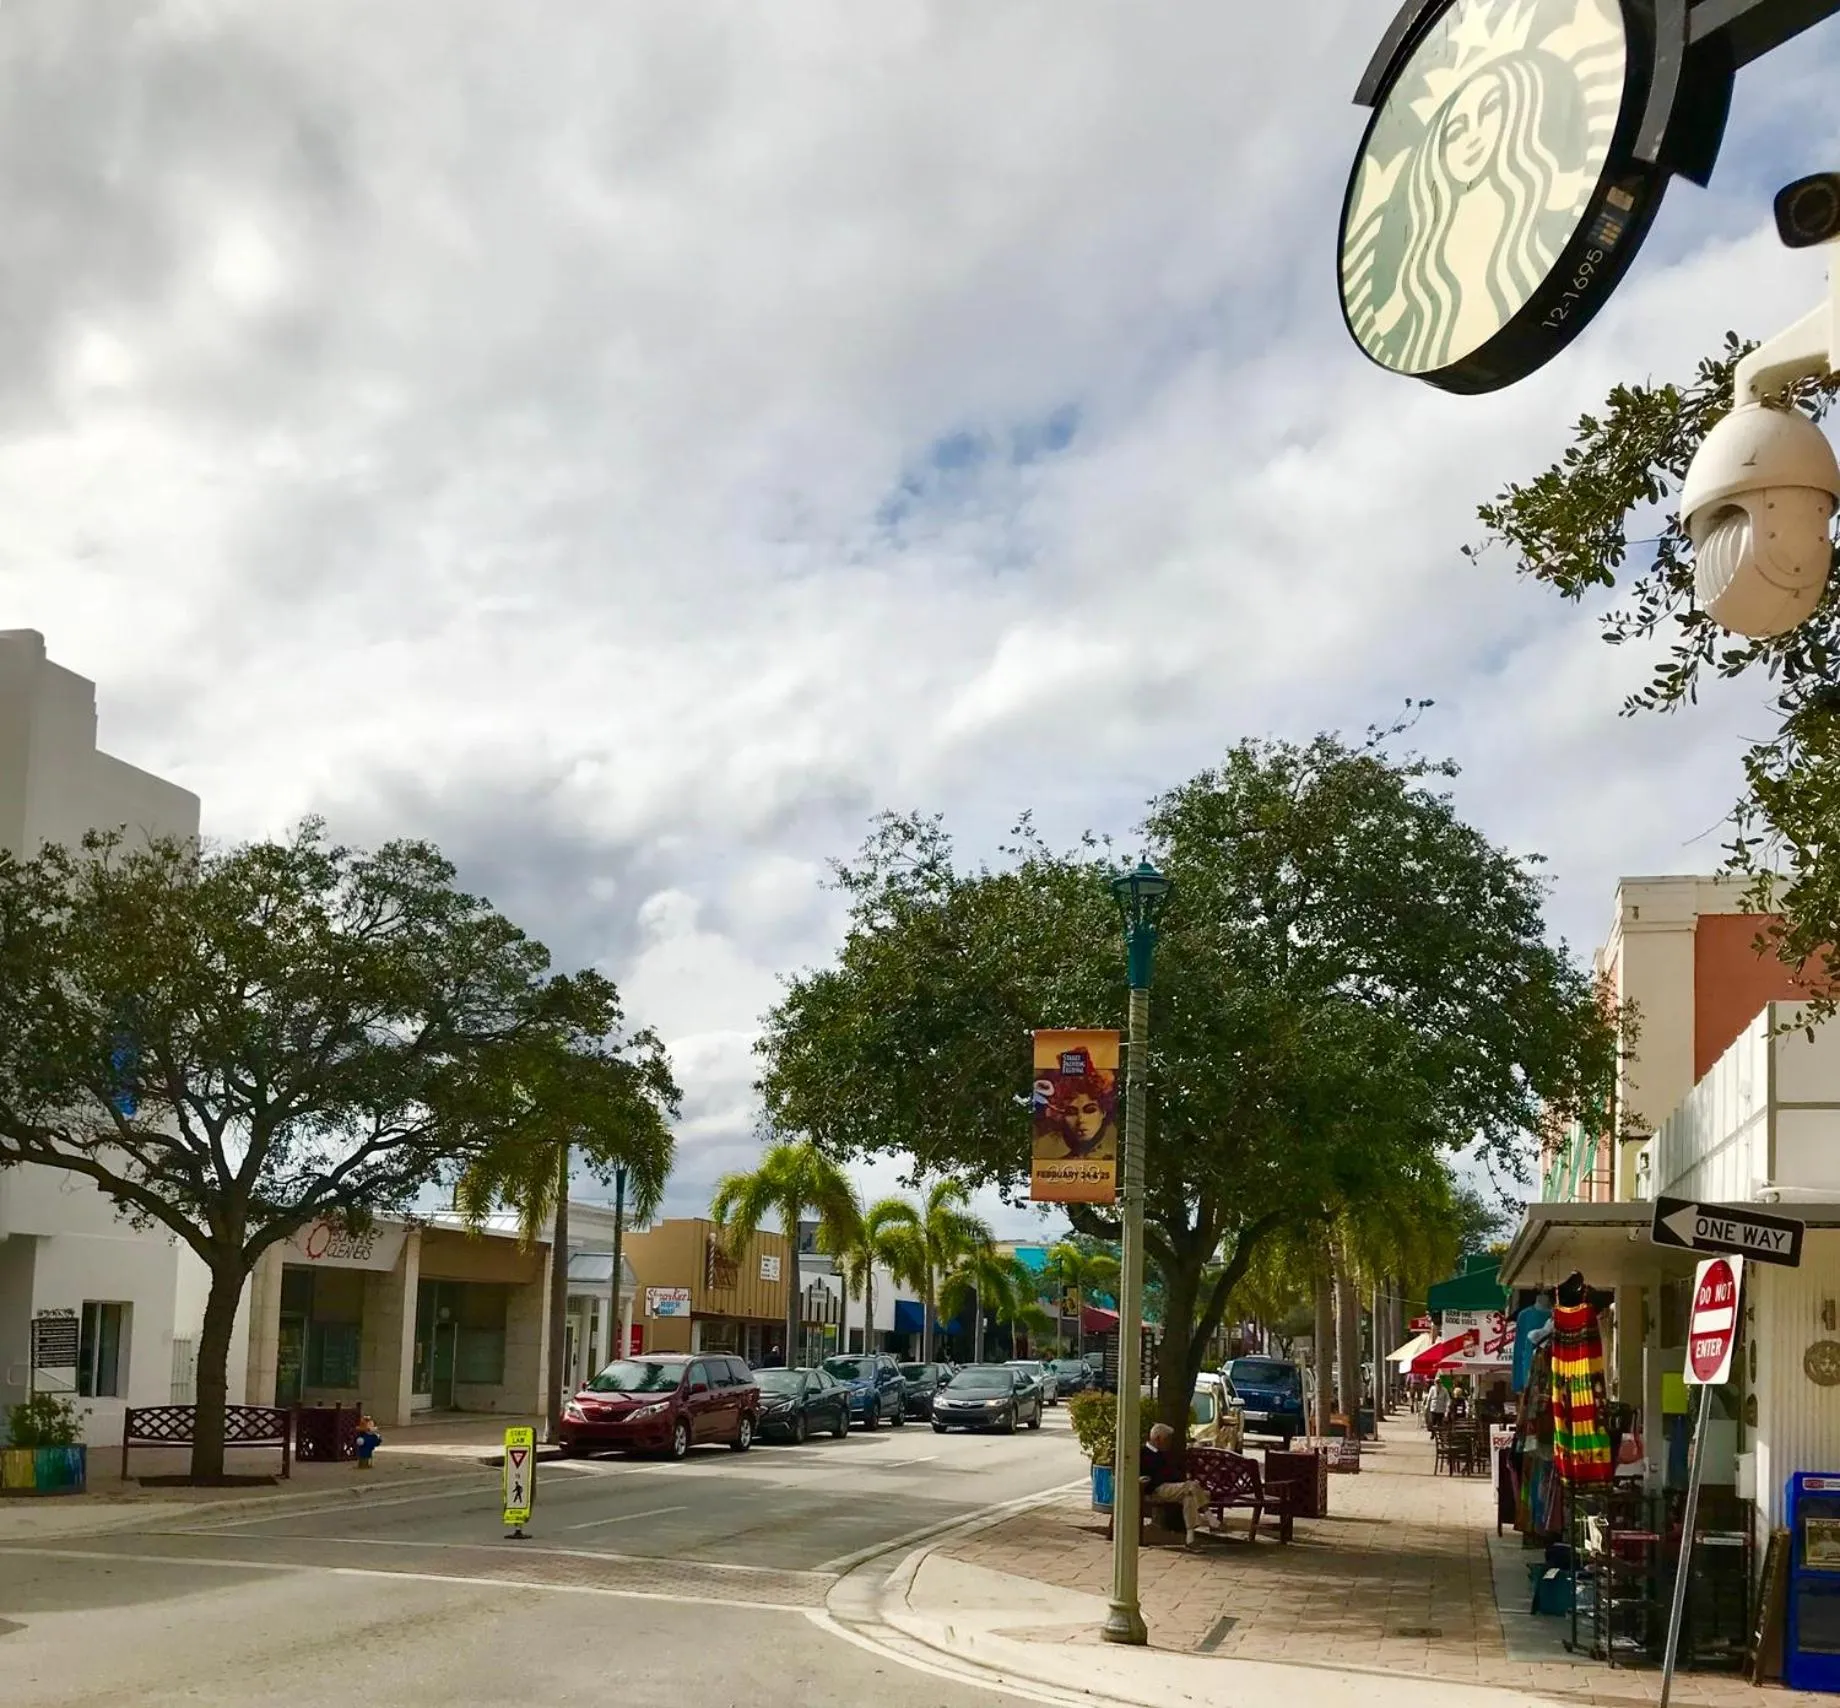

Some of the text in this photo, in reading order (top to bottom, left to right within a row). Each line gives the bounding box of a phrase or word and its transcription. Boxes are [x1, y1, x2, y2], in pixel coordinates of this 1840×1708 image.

[1542, 249, 1603, 327] 12-1695
[1696, 1218, 1787, 1250] ONE WAY
[1699, 1281, 1733, 1306] DO NOT
[1695, 1337, 1723, 1359] ENTER
